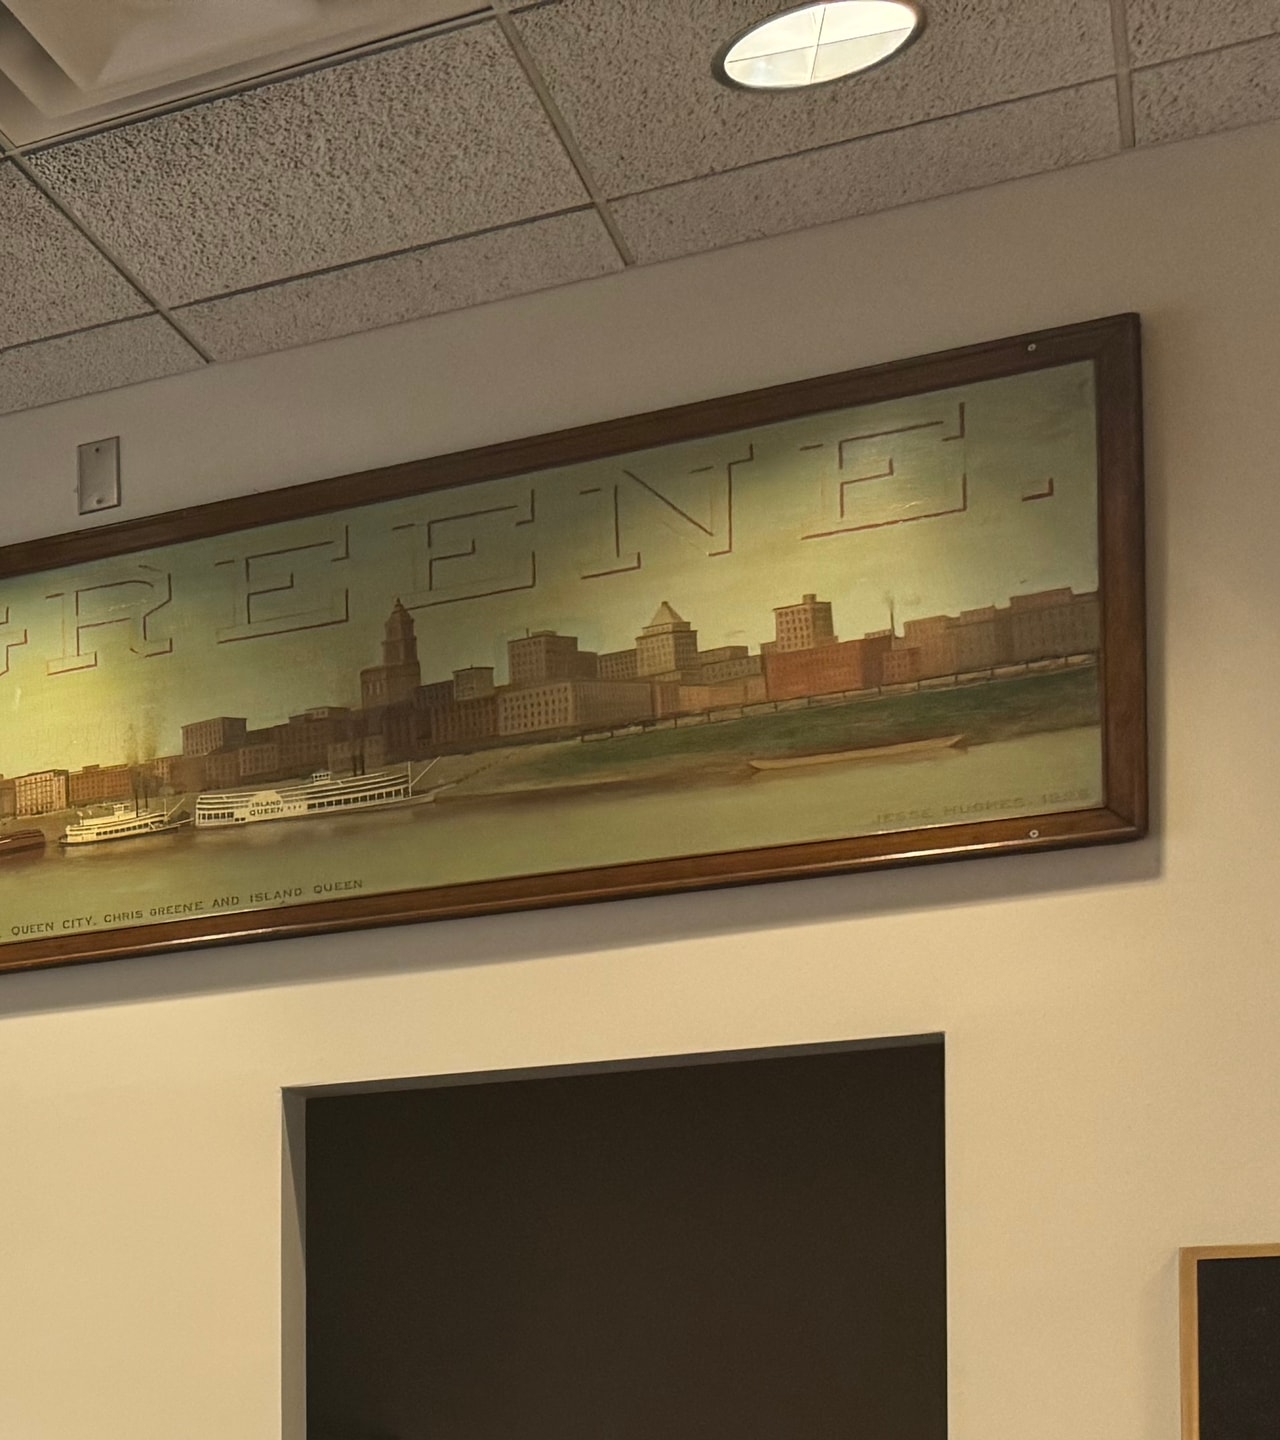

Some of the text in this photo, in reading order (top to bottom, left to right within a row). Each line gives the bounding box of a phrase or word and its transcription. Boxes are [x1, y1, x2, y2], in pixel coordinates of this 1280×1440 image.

[251, 800, 282, 808] ISLAND
[249, 807, 284, 817] QUEEN
[11, 921, 54, 936] QUEEN
[104, 910, 143, 923] CHRIS
[149, 900, 205, 917] GREENE
[212, 895, 240, 908] AND
[250, 887, 303, 903] ISLAND
[313, 879, 363, 895] QUEEN
